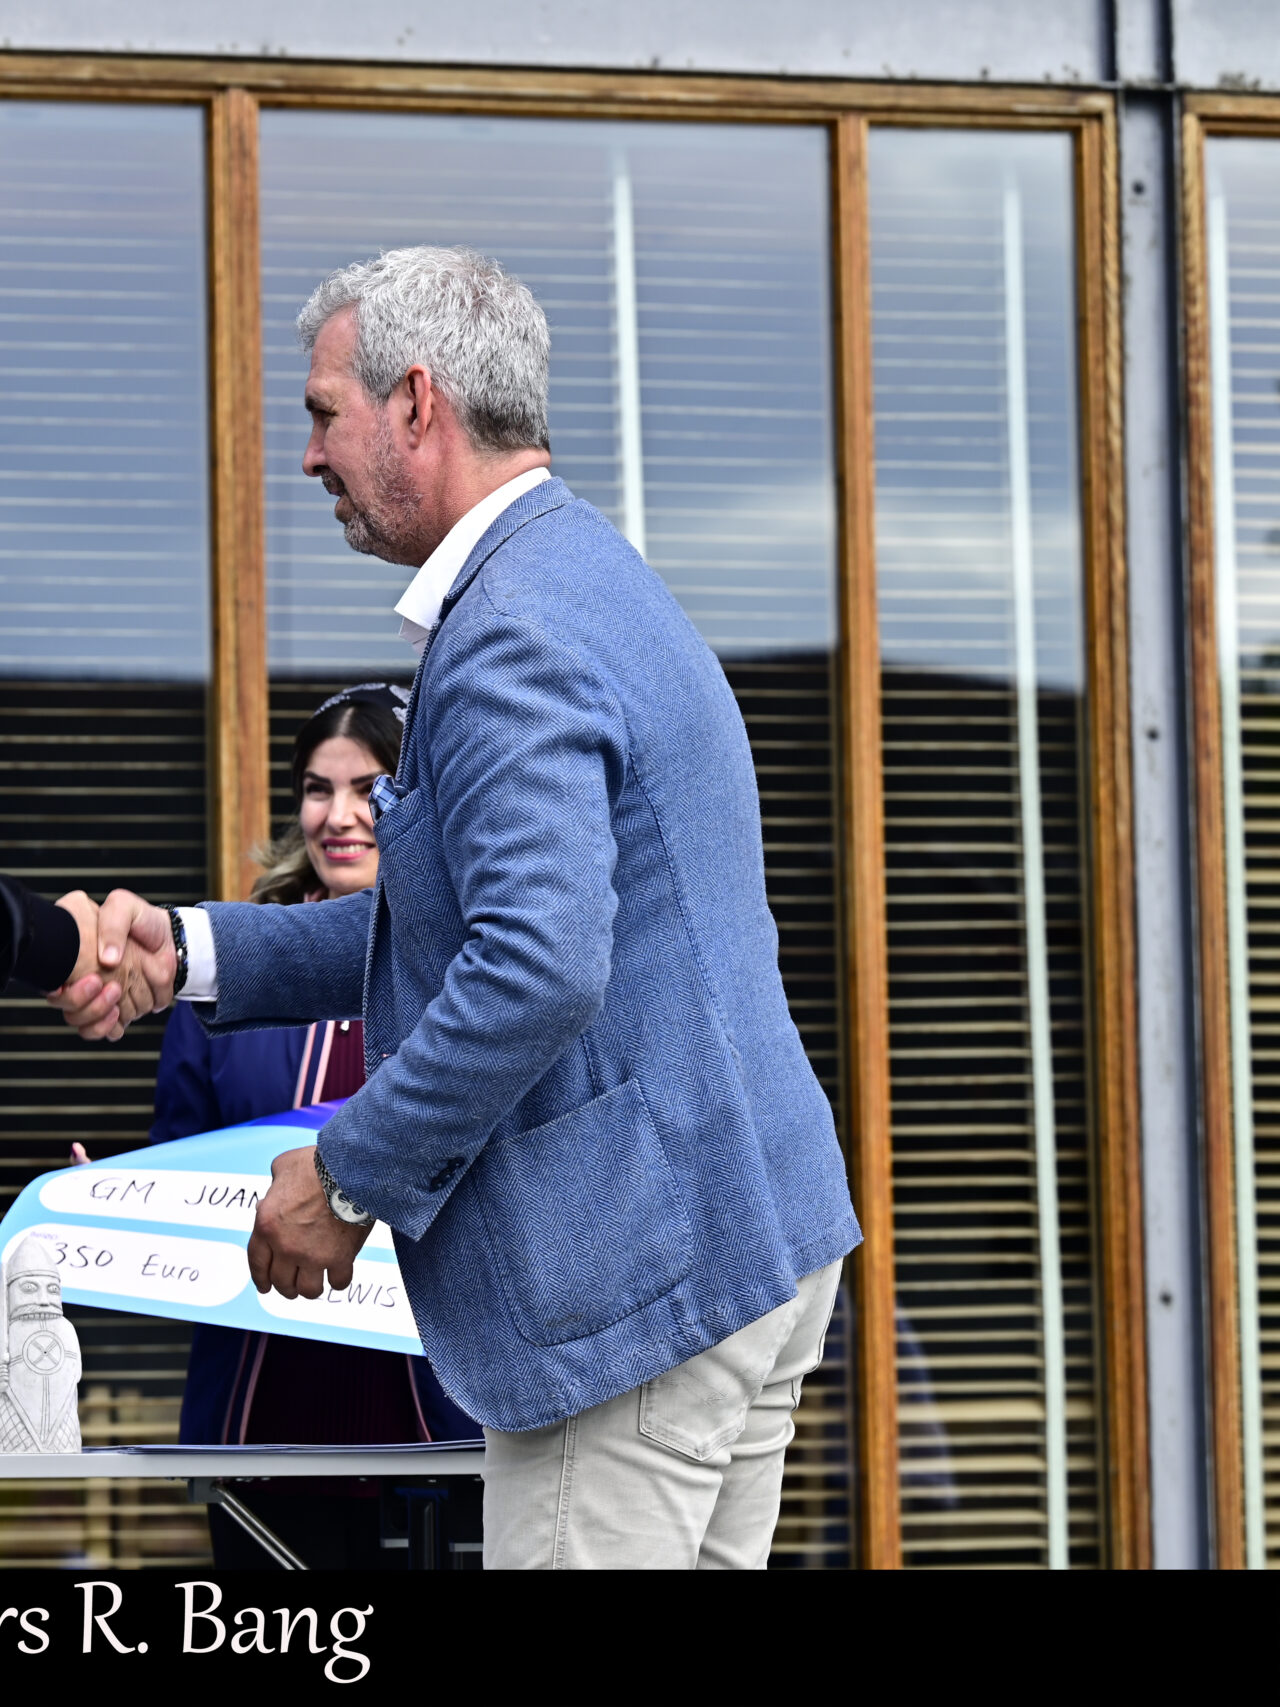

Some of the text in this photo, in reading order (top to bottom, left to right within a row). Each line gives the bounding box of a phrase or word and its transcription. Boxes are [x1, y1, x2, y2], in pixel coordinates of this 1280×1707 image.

[90, 1177, 155, 1204] GM
[55, 1242, 200, 1282] 350 Euro
[318, 1282, 398, 1308] EWIS
